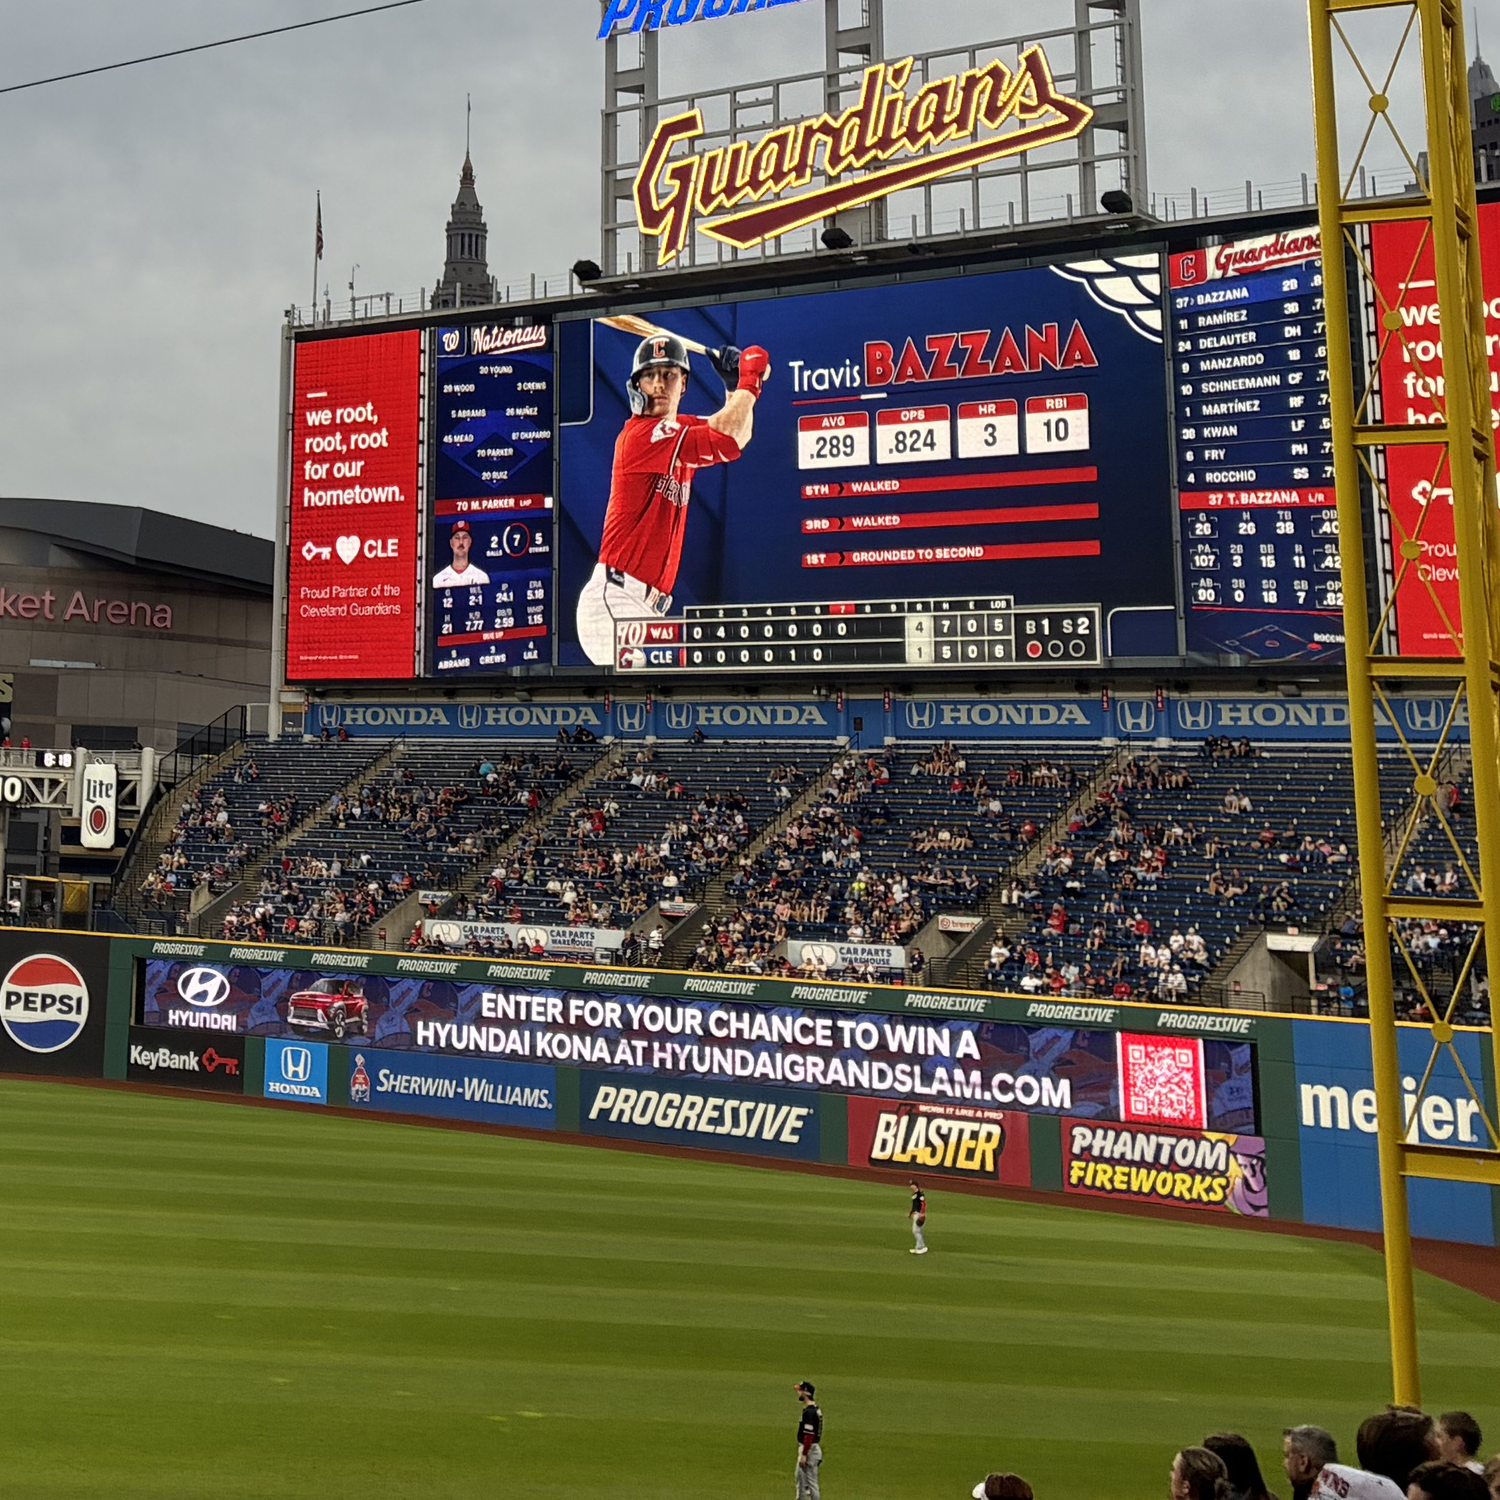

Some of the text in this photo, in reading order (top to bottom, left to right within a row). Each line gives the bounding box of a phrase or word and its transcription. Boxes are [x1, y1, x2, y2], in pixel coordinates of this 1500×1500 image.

[633, 43, 1094, 266] Guardians
[1197, 287, 1249, 305] BAZZANA
[1198, 309, 1247, 327] RAMÍREZ
[472, 325, 546, 355] Nationals
[1199, 332, 1256, 349] DELAUTER
[789, 319, 1098, 393] Travis BAZZANA
[1200, 353, 1264, 371] MANZARDO
[1201, 375, 1280, 393] SCHNEEMANN
[306, 402, 379, 426] we root,
[822, 398, 1067, 427] AVG OPS HR RBI
[1202, 399, 1260, 415] MARTÍNEZ
[809, 418, 1069, 459] .289 .824 3 10
[1203, 426, 1237, 437] KWAN
[305, 428, 388, 454] root, root
[1205, 449, 1225, 460] FRY
[304, 459, 365, 480] for our
[1206, 470, 1256, 483] ROCCHIO
[851, 480, 899, 492] WALKED
[303, 485, 404, 507] hometown.
[1209, 494, 1223, 505] 37
[851, 515, 900, 528] WALKED
[364, 539, 398, 558] CLE
[852, 550, 916, 563] GROUNDED
[917, 548, 933, 559] TO
[935, 546, 983, 559] SECOND
[300, 583, 400, 599] Proud Partner of the
[64, 590, 172, 628] Arena
[300, 602, 401, 617] Cleveland Guardians
[650, 627, 673, 640] WAS
[650, 651, 673, 664] CLE
[343, 707, 450, 726] HONDA
[485, 707, 601, 726] HONDA
[696, 706, 827, 726] HONDA
[940, 704, 1090, 725] HONDA
[85, 779, 113, 803] Lite
[462, 926, 505, 936] CAR PARTS
[550, 930, 595, 940] CAR PARTS
[152, 942, 207, 957] PROGRESSIVE
[229, 948, 288, 962] PROGRESSIVE
[839, 947, 892, 957] CAR PARTS
[311, 953, 372, 968] PROGRESSIVE
[397, 959, 461, 974] PROGRESSIVE
[487, 965, 555, 982] PROGRESSIVE
[583, 972, 654, 988] PROGRESSIVE
[683, 978, 759, 995] PROGRESSIVE
[791, 986, 872, 1004] PROGRESSIVE
[5, 992, 83, 1016] PEPSI
[904, 994, 991, 1012] PROGRESSIVE
[168, 1010, 236, 1031] HYUNDAI
[1027, 1003, 1119, 1023] PROGRESSIVE
[482, 992, 981, 1060] ENTER FOR YOUR CHANCE TO WIN A
[1157, 1013, 1256, 1033] PROGRESSIVE
[130, 1045, 199, 1073] KeyBank
[417, 1021, 1072, 1108] HYUNDAI KONA AT HYUNDAIGRANDSLAM.COM
[268, 1082, 321, 1098] HONDA
[377, 1069, 552, 1110] SHERWIN-WILLIAMS.
[589, 1086, 814, 1143] PROGRESSIVE
[871, 1113, 1001, 1172] BLASTER
[1071, 1126, 1229, 1171] PHANTOM
[1069, 1161, 1227, 1202] FIREWORKS
